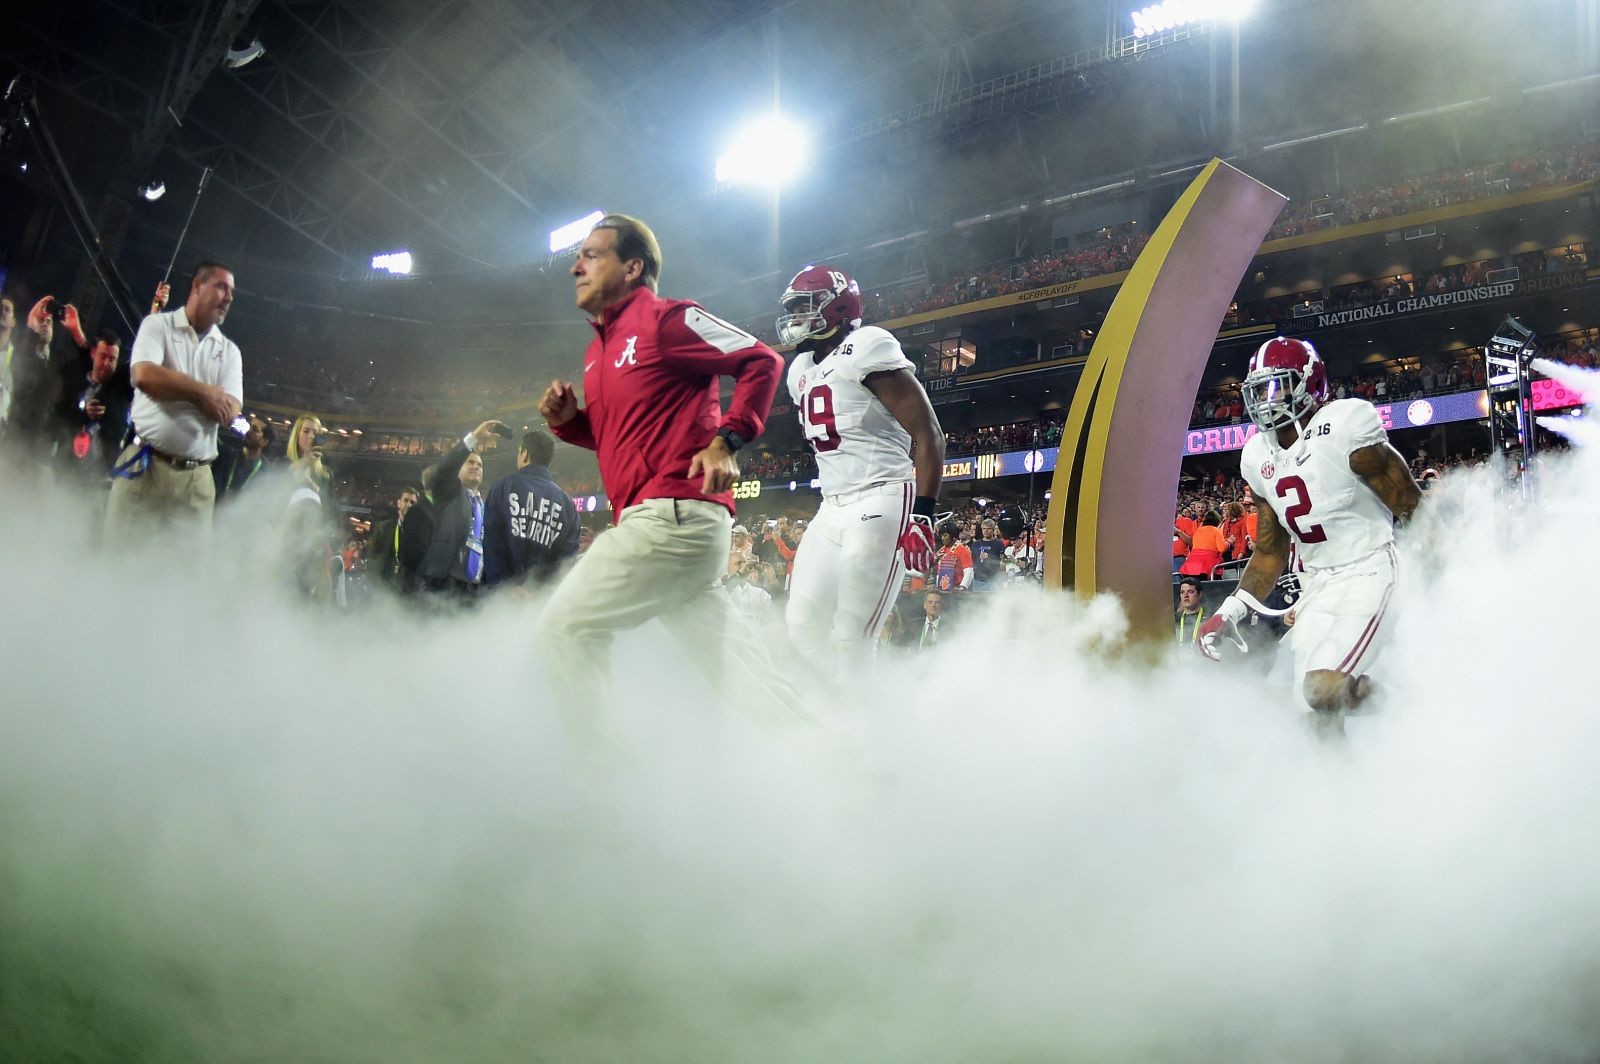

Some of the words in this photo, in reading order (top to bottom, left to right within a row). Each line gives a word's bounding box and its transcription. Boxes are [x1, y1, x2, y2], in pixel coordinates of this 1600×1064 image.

[827, 271, 848, 296] 19
[1018, 283, 1078, 300] #CFBPLAYOFF
[1318, 303, 1395, 327] NATIONAL
[1397, 283, 1515, 313] CHAMPIONSHIP
[929, 377, 953, 391] TIDE
[509, 491, 563, 530] S.A.F.E.
[1275, 475, 1327, 543] 2
